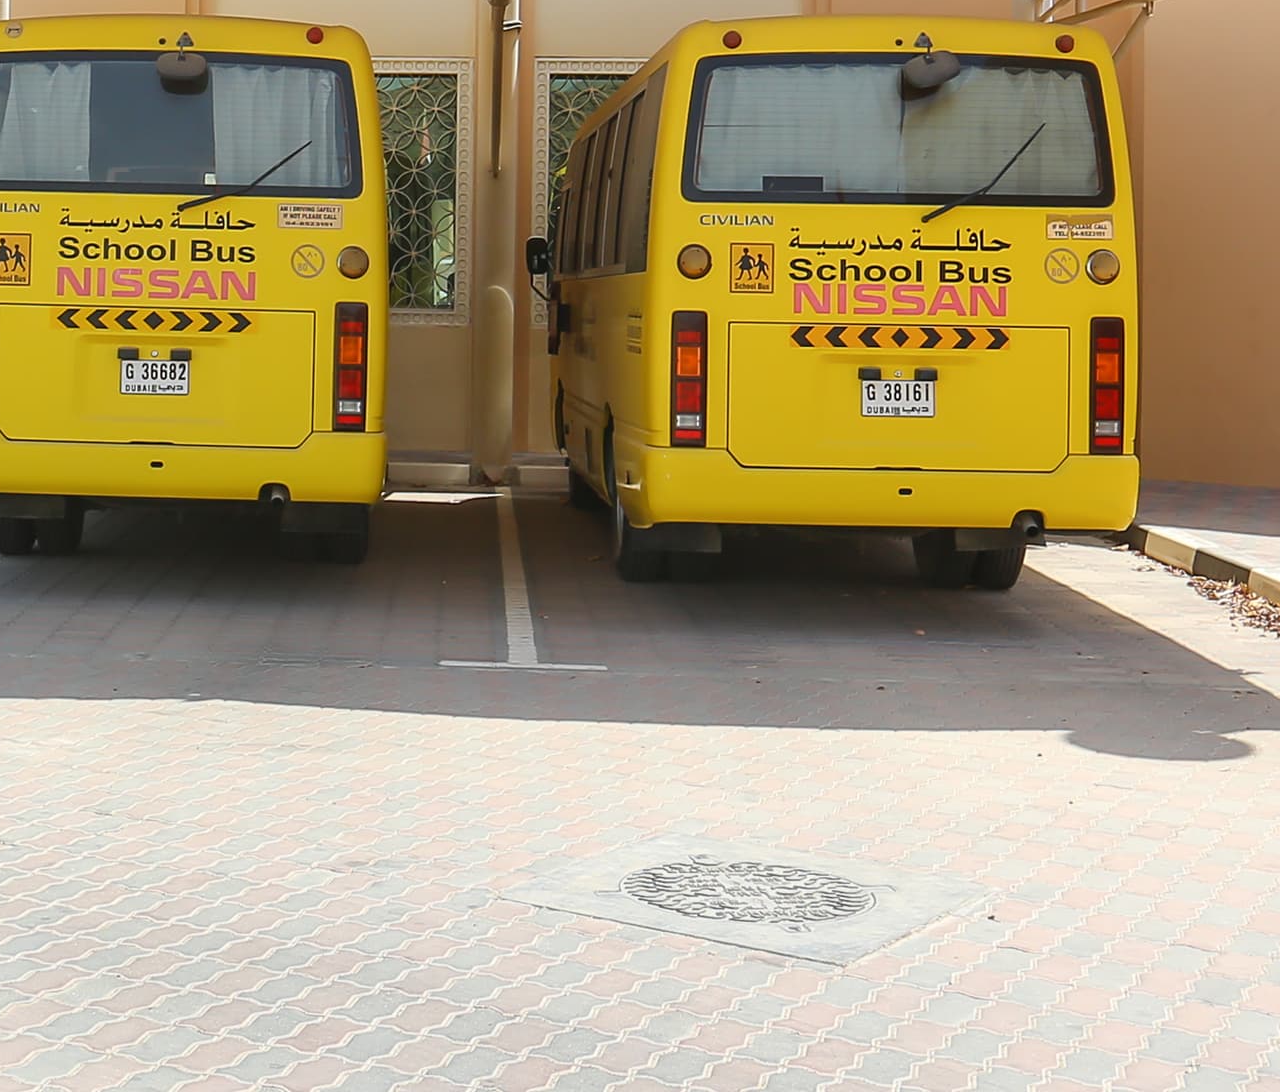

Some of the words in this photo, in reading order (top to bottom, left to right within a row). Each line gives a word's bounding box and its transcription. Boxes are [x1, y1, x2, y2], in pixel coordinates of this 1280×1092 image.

[59, 208, 163, 233] مدرسية
[170, 209, 257, 230] حافلة
[699, 214, 774, 226] CIVILIAN
[58, 237, 176, 261] School
[190, 239, 257, 263] Bus
[788, 227, 903, 255] مدرسية
[910, 227, 1011, 252] حافلة
[56, 266, 257, 301] NISSAN
[788, 258, 921, 282] School
[939, 261, 1012, 284] Bus
[734, 282, 757, 290] School
[793, 283, 1007, 316] NISSAN
[126, 363, 134, 379] G
[141, 363, 186, 380] 36682
[867, 383, 876, 401] G
[884, 383, 929, 401] 38161
